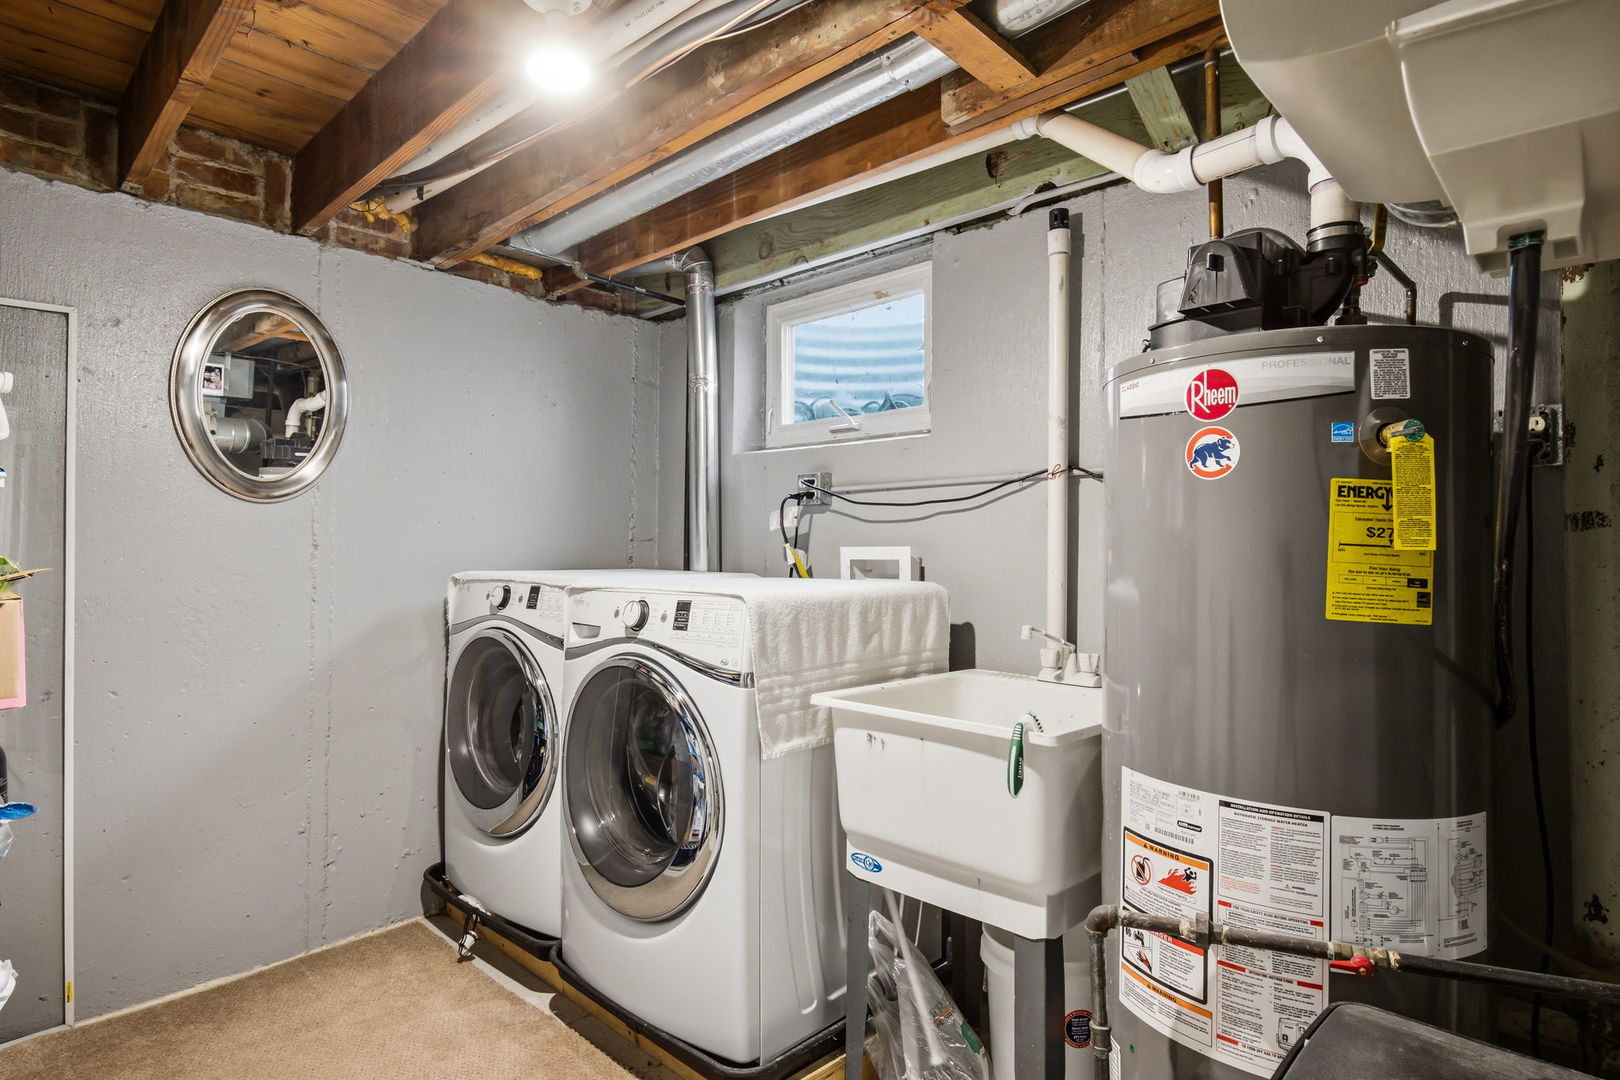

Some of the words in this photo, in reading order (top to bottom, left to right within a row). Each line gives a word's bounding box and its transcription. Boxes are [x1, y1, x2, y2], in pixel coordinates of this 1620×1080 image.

[1190, 369, 1236, 414] Rheem
[1337, 485, 1394, 501] ENERGY
[1149, 844, 1180, 861] WARNING
[1152, 986, 1177, 1003] WARNING
